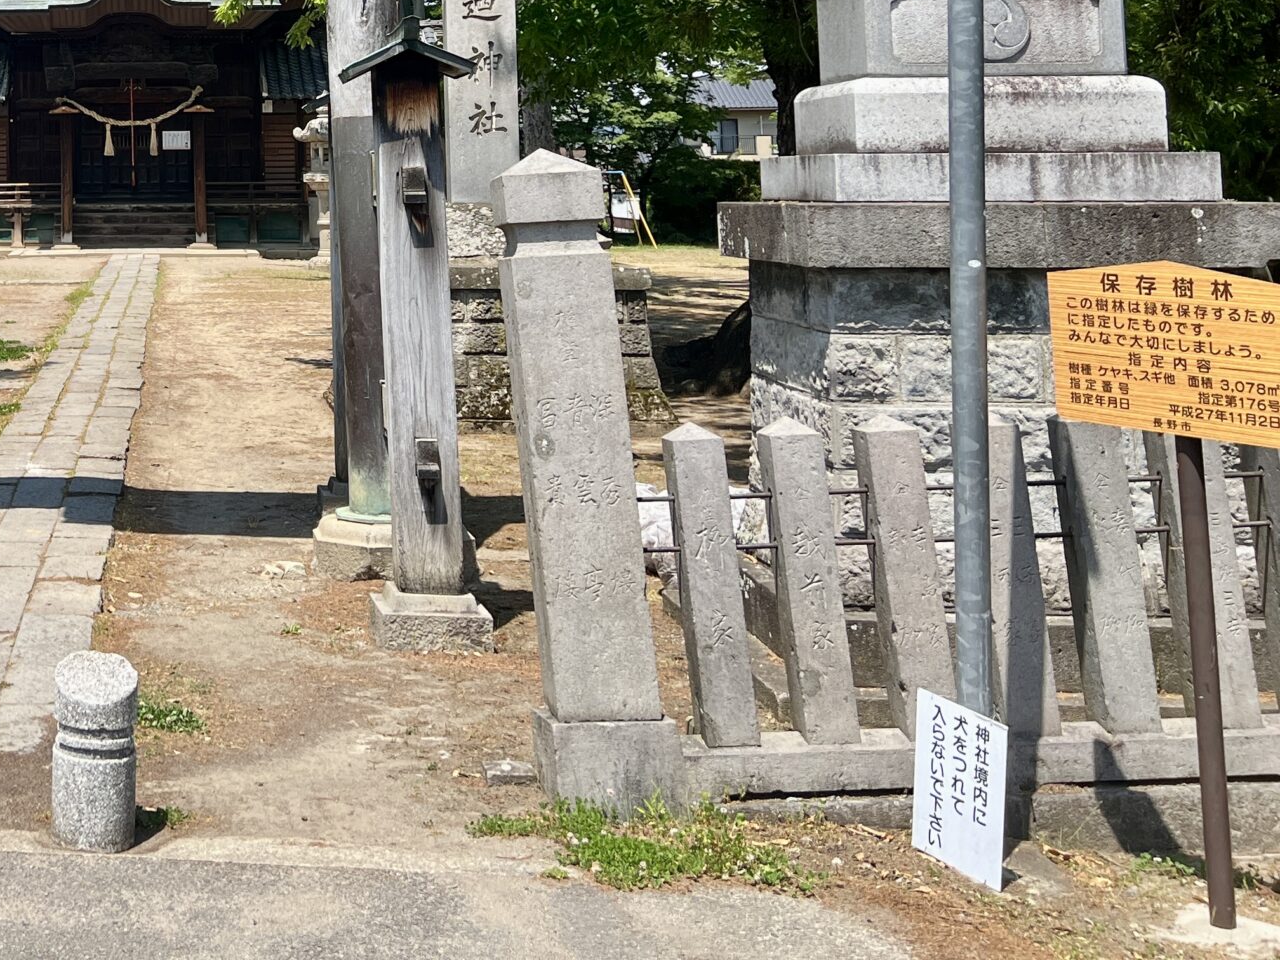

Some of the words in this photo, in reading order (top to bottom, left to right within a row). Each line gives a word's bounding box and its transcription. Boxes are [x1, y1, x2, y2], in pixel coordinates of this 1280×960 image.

[1100, 272, 1234, 300] 保存樹林
[1066, 296, 1275, 325] この樹林は緑を保存するため
[1067, 313, 1213, 337] に指定したものです。
[1068, 329, 1262, 360] みんなで大切にしましょう。
[1068, 362, 1092, 375] 樹種
[1187, 375, 1213, 389] 面積
[1128, 352, 1211, 373] 指定内容
[1069, 377, 1130, 395] 指定番号
[1197, 392, 1280, 413] 指定第176号
[1070, 392, 1130, 410] 指定年月日
[1169, 403, 1280, 428] 平成27年11月2日
[1153, 418, 1192, 432] 長野市
[928, 704, 946, 849] 入らないで下さい
[951, 715, 969, 816] 犬をつれて
[973, 724, 990, 826] 神社境内に
